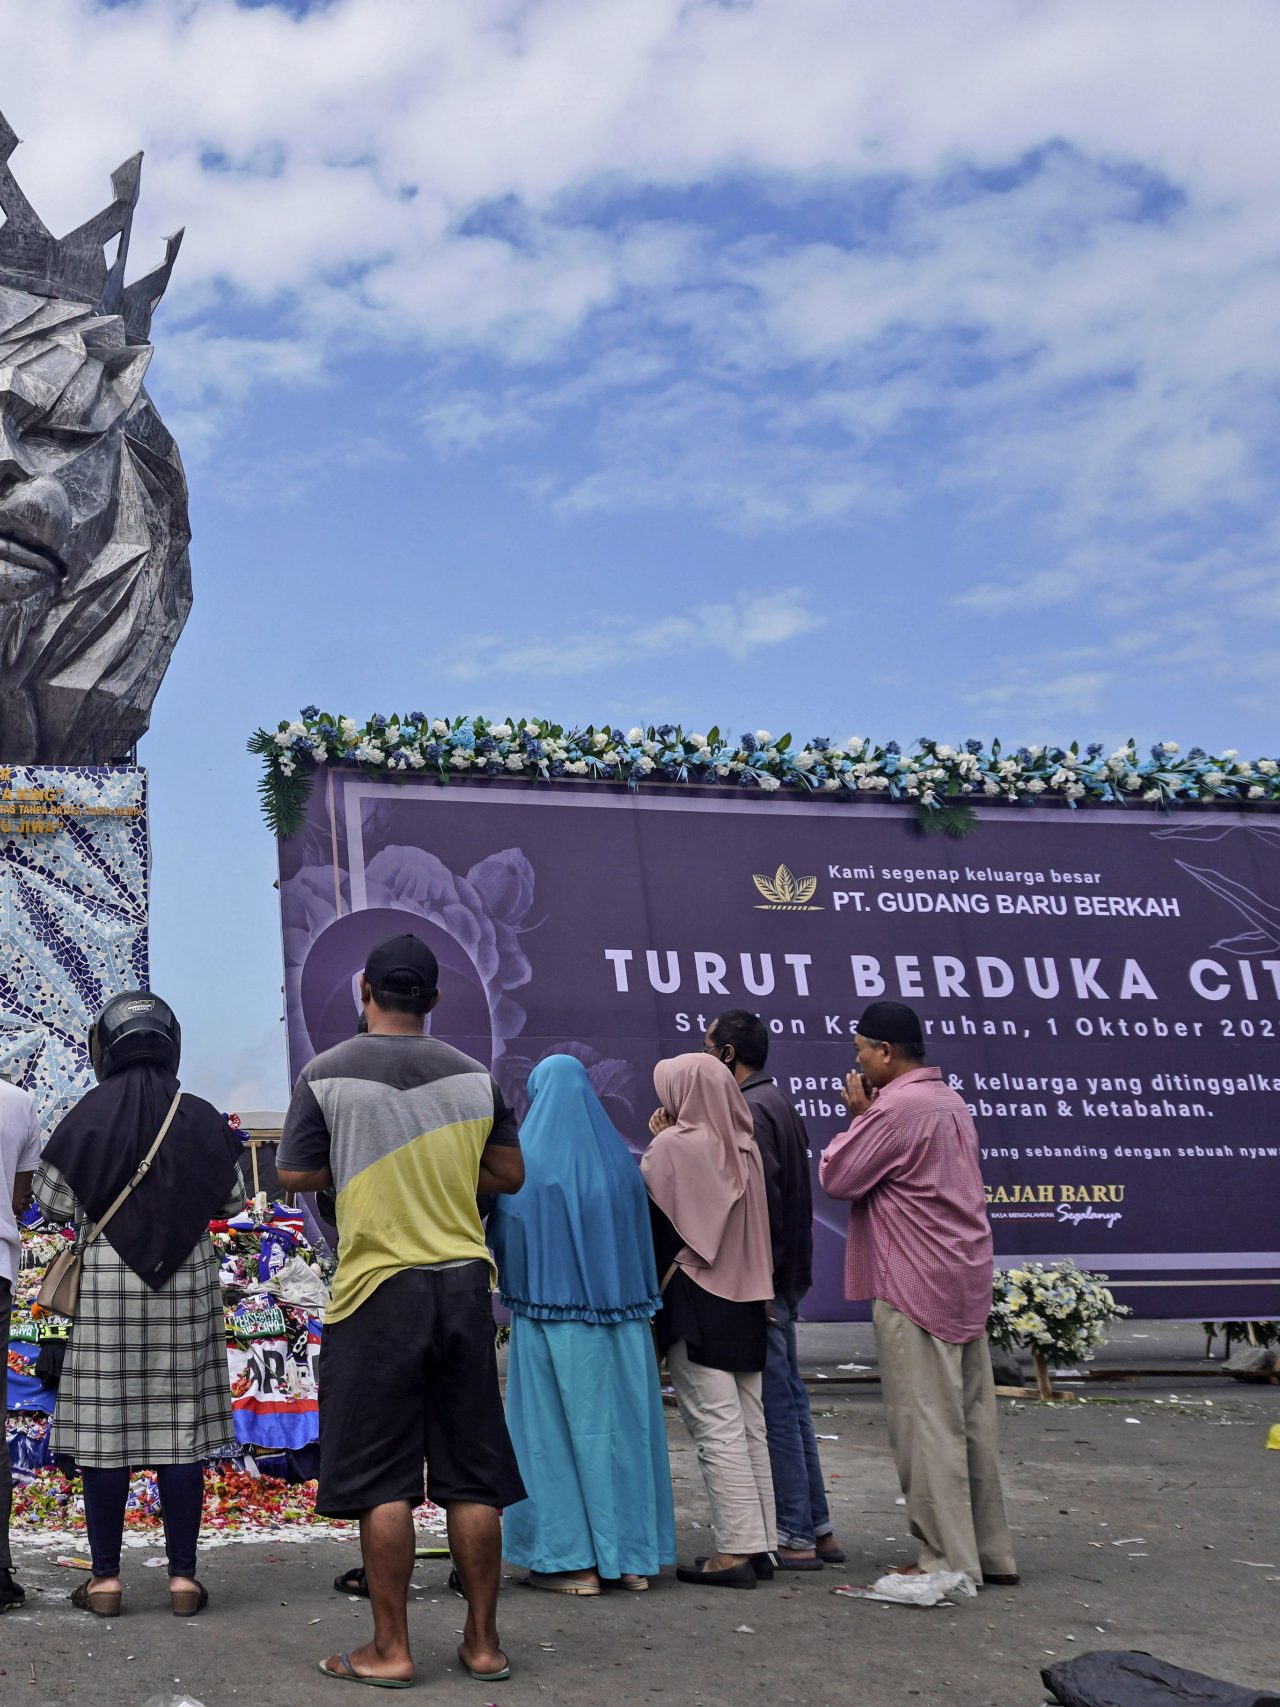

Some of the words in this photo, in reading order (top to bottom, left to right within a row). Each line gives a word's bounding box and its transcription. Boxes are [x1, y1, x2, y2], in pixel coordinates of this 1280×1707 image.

[1, 788, 14, 801] A
[828, 865, 876, 879] Kami
[882, 867, 960, 883] segenap
[965, 867, 1045, 885] keluarga
[1049, 869, 1101, 884] besar
[833, 891, 870, 911] PT.
[877, 892, 989, 913] GUDANG
[995, 894, 1068, 916] BARU
[1073, 896, 1181, 917] BERKAH
[604, 949, 812, 996] TURUT
[850, 954, 1158, 1000] BERDUKA
[675, 1012, 806, 1034] Ston
[825, 1015, 1031, 1038] Karuhan,
[1047, 1017, 1058, 1036] 1
[1076, 1016, 1203, 1037] Oktober
[1220, 1019, 1280, 1037] 202
[790, 1072, 844, 1093] para
[948, 1073, 964, 1090] &
[974, 1072, 1078, 1095] keluarga
[1086, 1077, 1143, 1095] yang
[795, 1099, 848, 1117] dibe
[968, 1099, 1047, 1117] abaran
[1057, 1100, 1073, 1117] &
[1081, 1099, 1214, 1117] ketabahan.
[981, 1147, 1019, 1159] yang
[1026, 1145, 1108, 1159] sebanding
[1114, 1145, 1171, 1159] dengan
[1178, 1145, 1234, 1157] sebuah
[1239, 1147, 1280, 1160] nyaw
[1060, 1185, 1126, 1203] BARU
[1056, 1203, 1123, 1229] Segalanya
